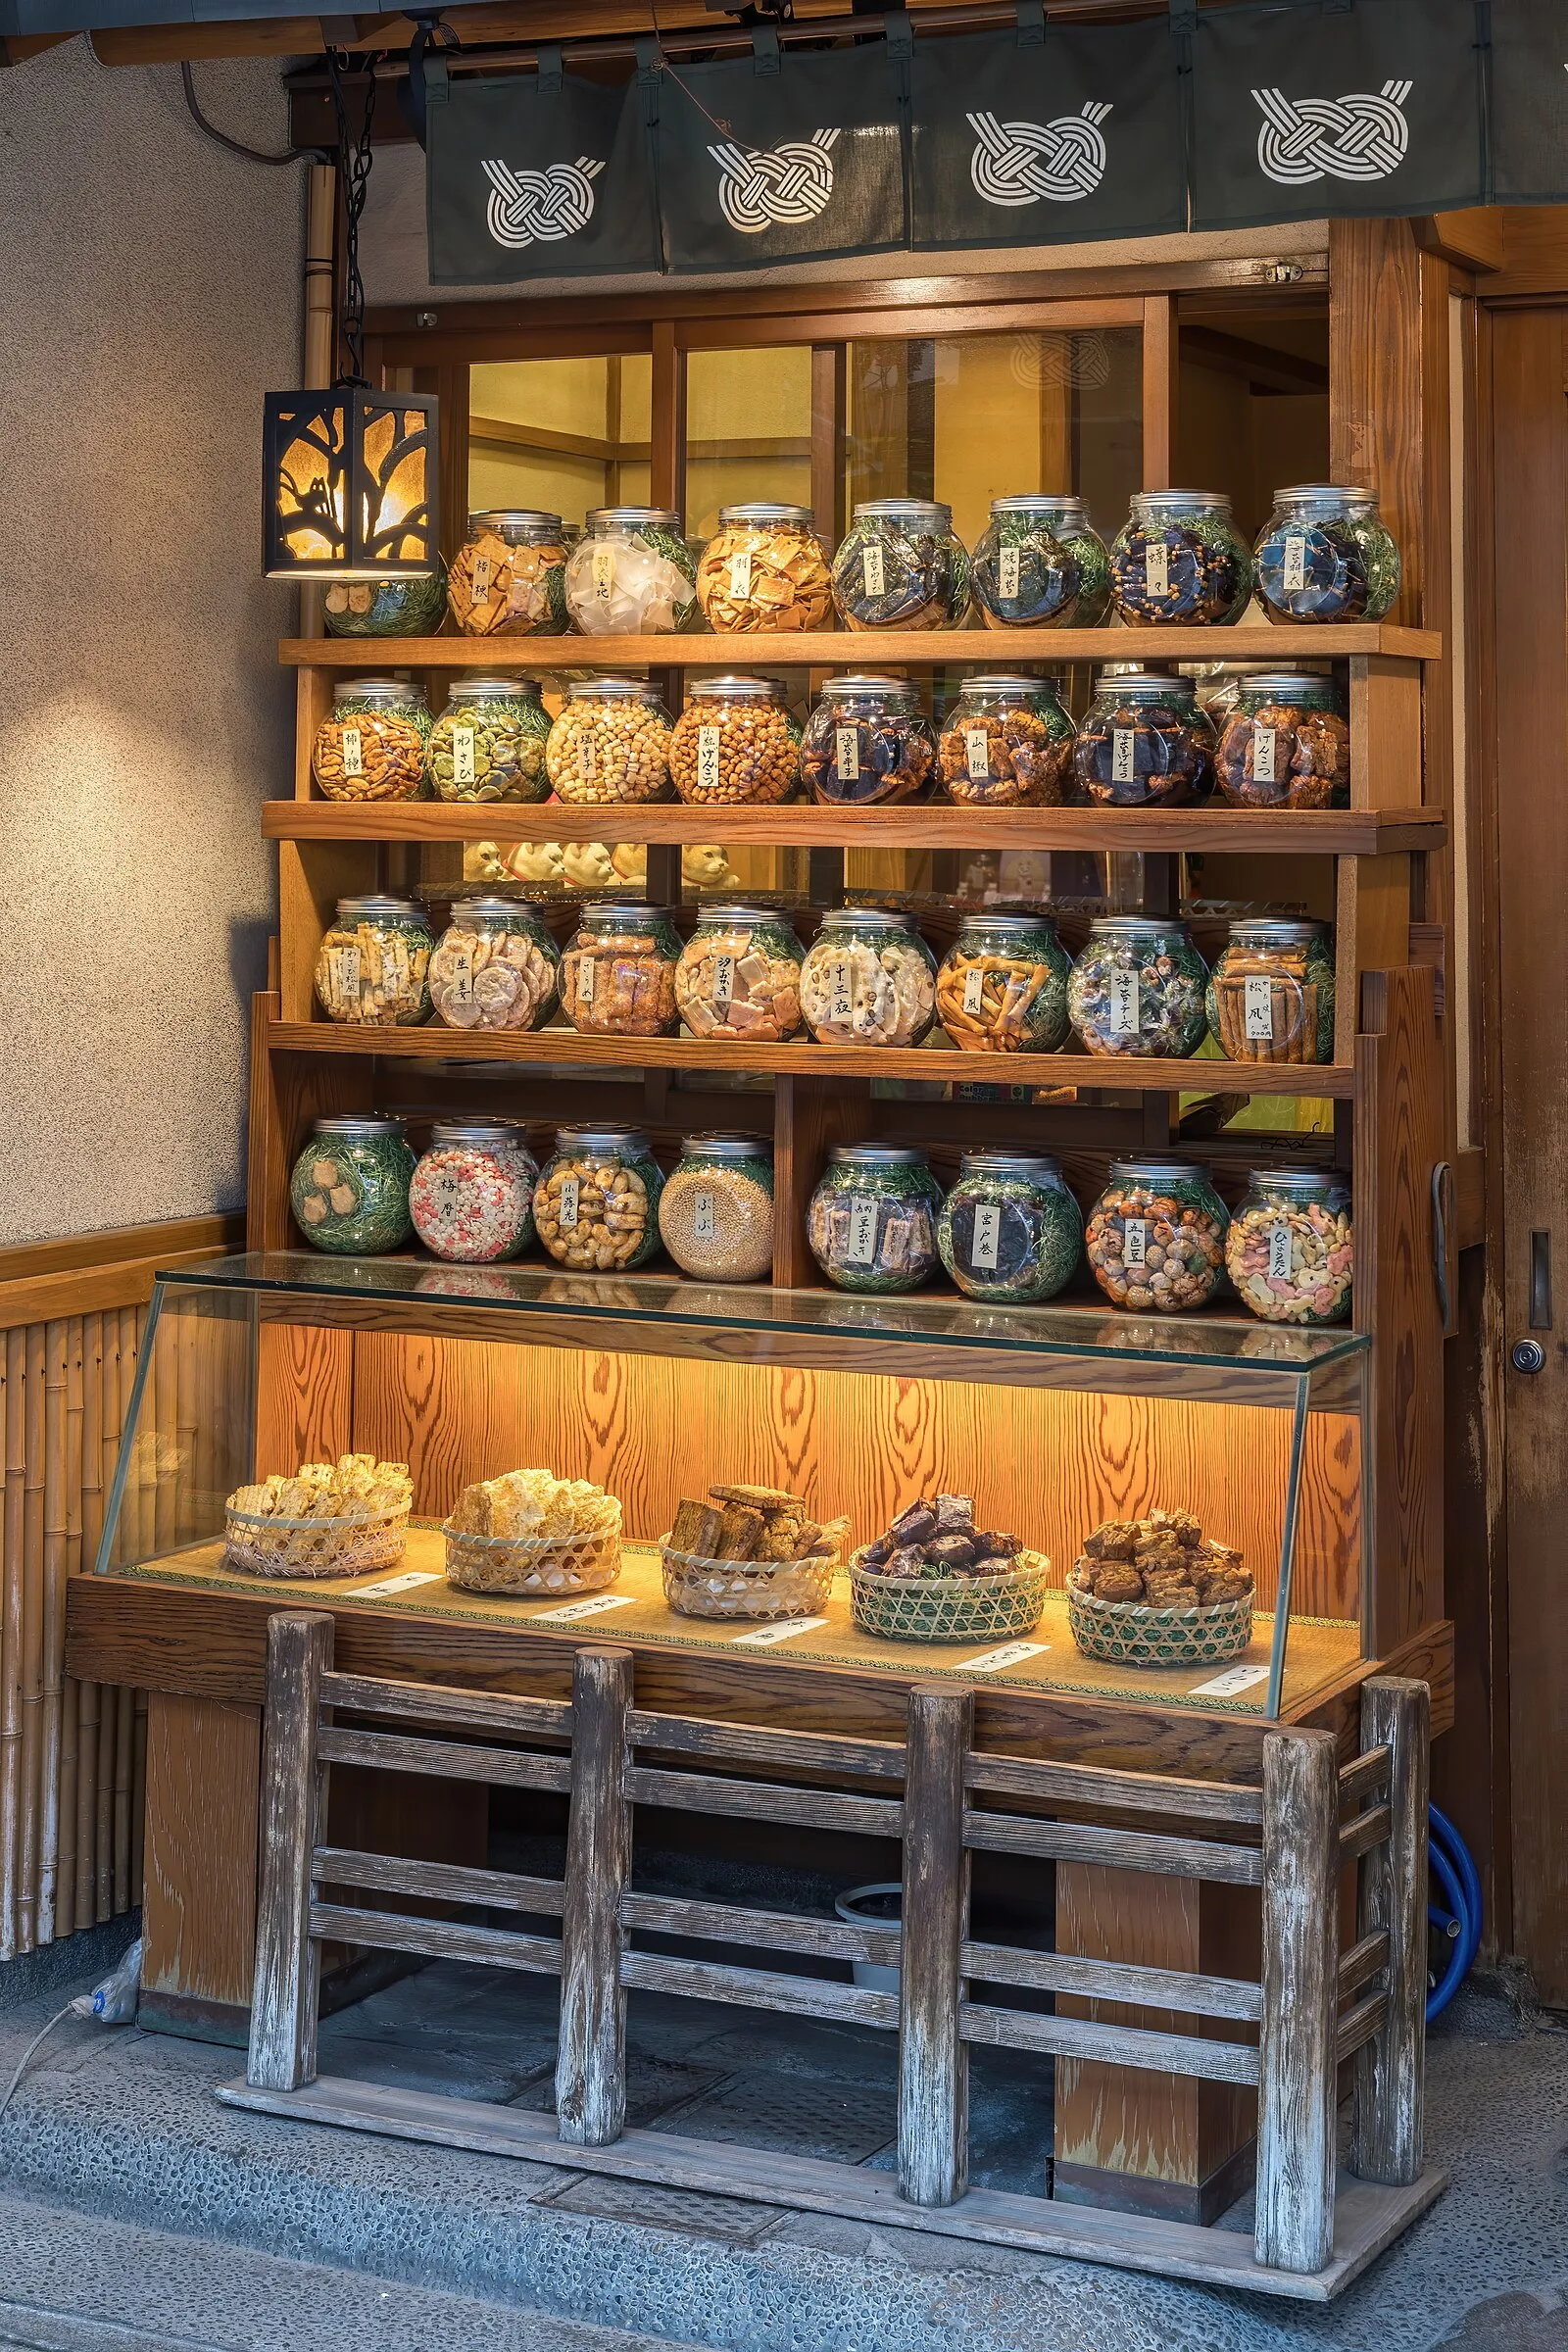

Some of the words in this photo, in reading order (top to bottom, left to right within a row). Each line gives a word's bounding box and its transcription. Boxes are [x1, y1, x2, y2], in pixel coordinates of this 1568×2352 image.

[473, 560, 488, 598] 桔梗
[735, 557, 748, 596] 羽衣
[1001, 551, 1017, 595] 焼海苔
[1287, 540, 1303, 587] 海苔羽衣
[456, 735, 472, 780] わさび
[702, 727, 718, 786] 小粒げんこつ
[840, 732, 857, 777] 海苔辛子
[971, 736, 987, 773] 山椒
[1115, 732, 1133, 779] 海苔げんこつ
[1257, 732, 1273, 776] げんこつ
[345, 950, 359, 994] わさび松風
[456, 956, 471, 1001] 生姜
[717, 956, 731, 997] 汐おかき
[834, 964, 853, 1015] 十三夜
[966, 970, 979, 1011] 松風
[1115, 973, 1134, 1031] 海苔チーズ
[1248, 982, 1263, 1020] 松風
[563, 1184, 576, 1222] 小落花
[698, 1198, 711, 1232] ぶぶ
[854, 1203, 872, 1257] 納豆おかき
[978, 1212, 994, 1255] 宮戸巻
[1127, 1222, 1144, 1263] 五色豆
[1272, 1231, 1287, 1277] ひょうたん
